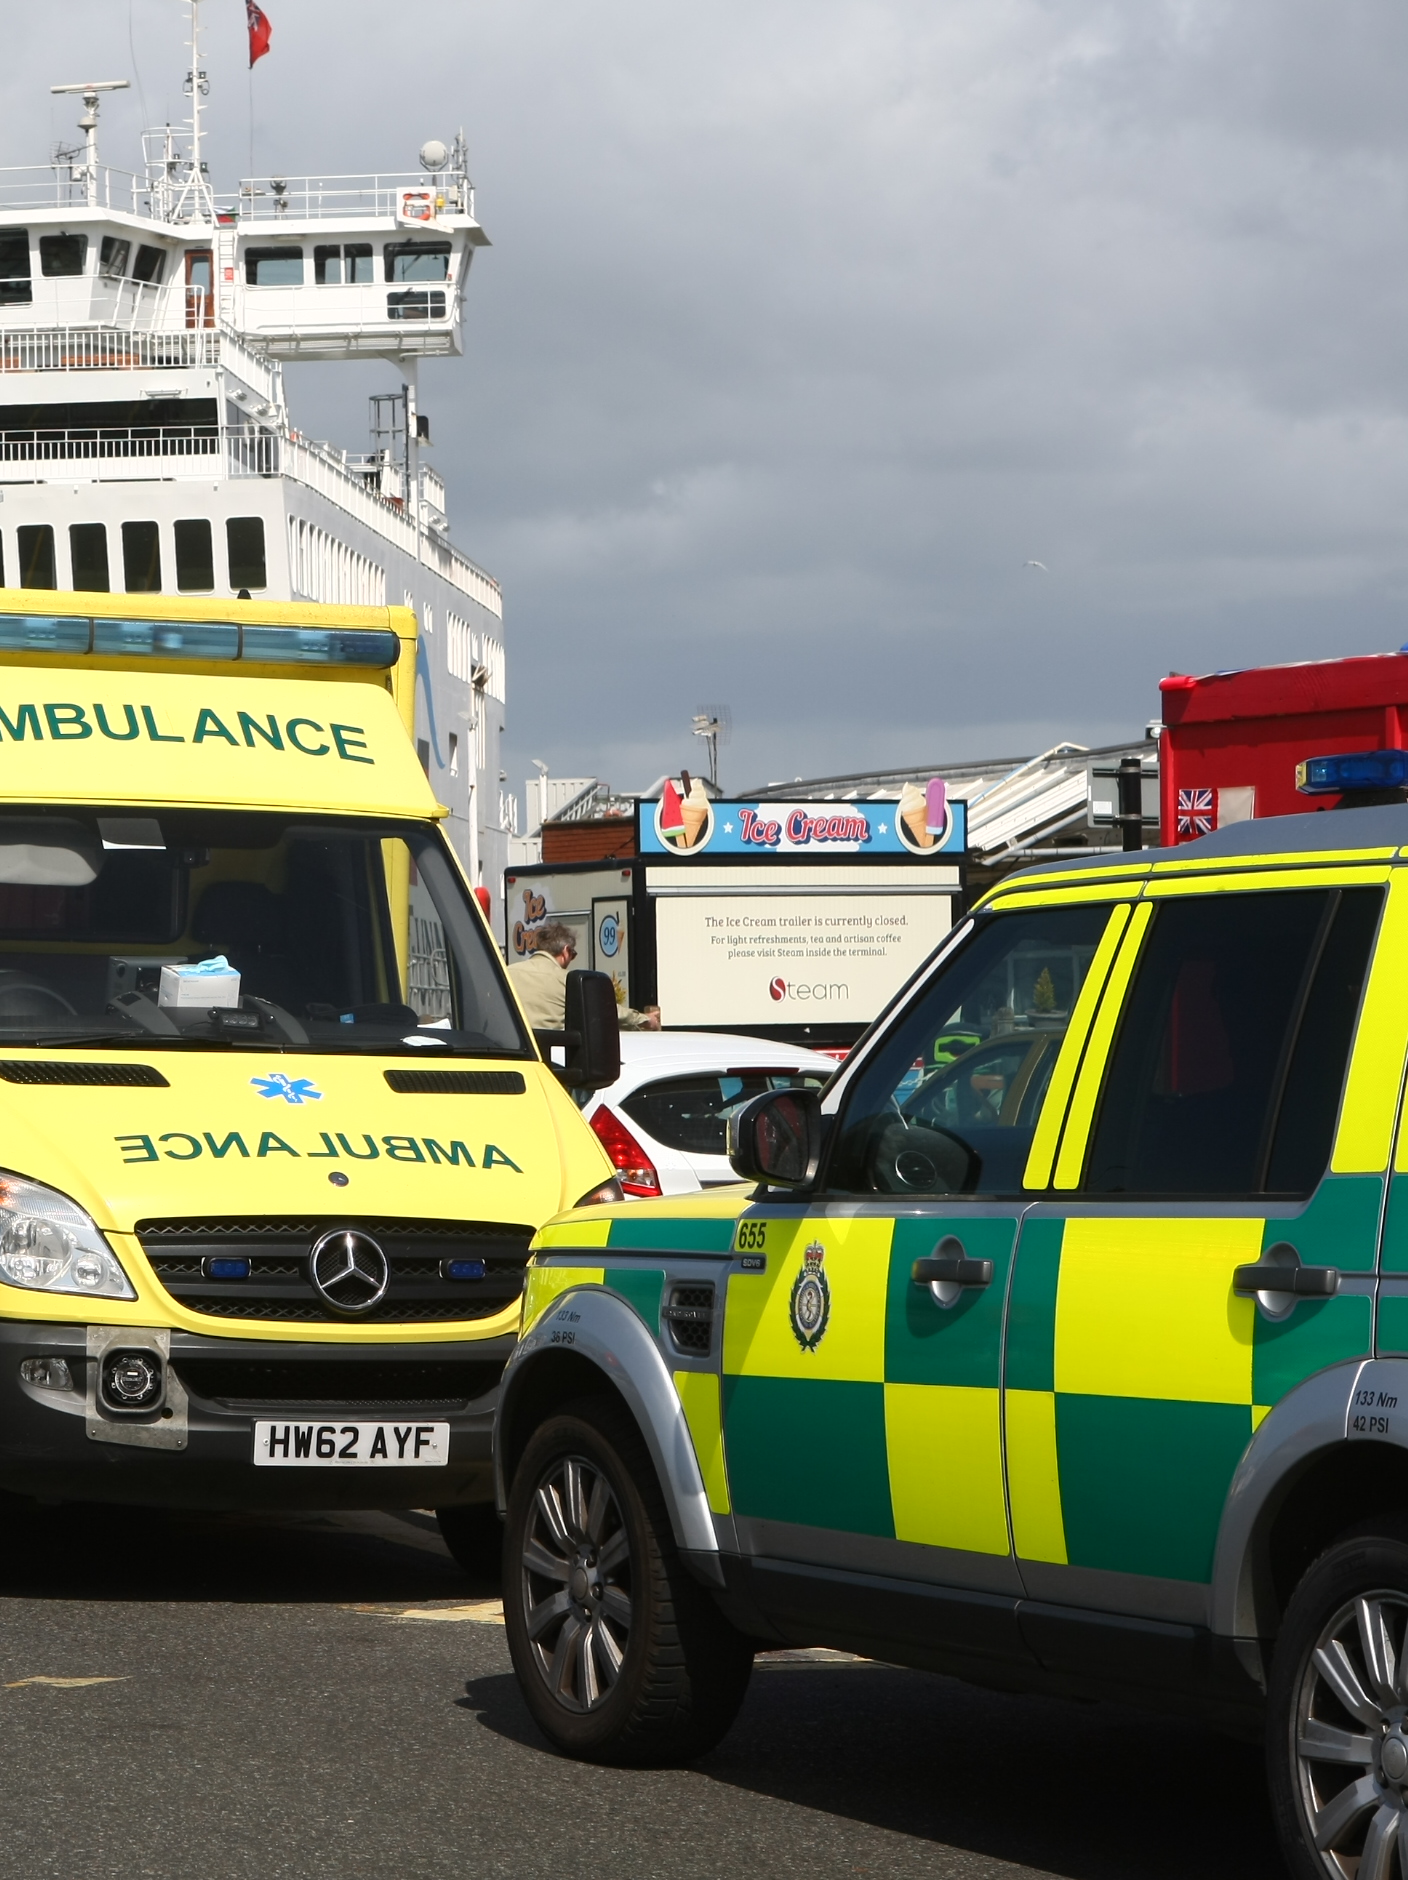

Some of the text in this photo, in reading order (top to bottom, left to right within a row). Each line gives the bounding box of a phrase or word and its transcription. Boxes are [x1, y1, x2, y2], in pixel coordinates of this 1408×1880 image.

[738, 808, 871, 844] Ice Cream
[523, 889, 546, 924] Ice
[705, 915, 908, 928] The Ice Cream trailer is currently closed.
[603, 926, 616, 946] 99
[711, 933, 901, 946] For light refreshments, tea and artisan coffee
[728, 946, 887, 959] please visit Steam inside the terminal.
[769, 975, 849, 1003] Steam
[738, 1222, 767, 1249] 655
[567, 1311, 581, 1323] Nm
[551, 1331, 575, 1344] 36 PSI
[1355, 1390, 1398, 1408] 133 Nm
[1353, 1415, 1389, 1433] 42 PSI
[269, 1425, 434, 1459] HW62 AYF
